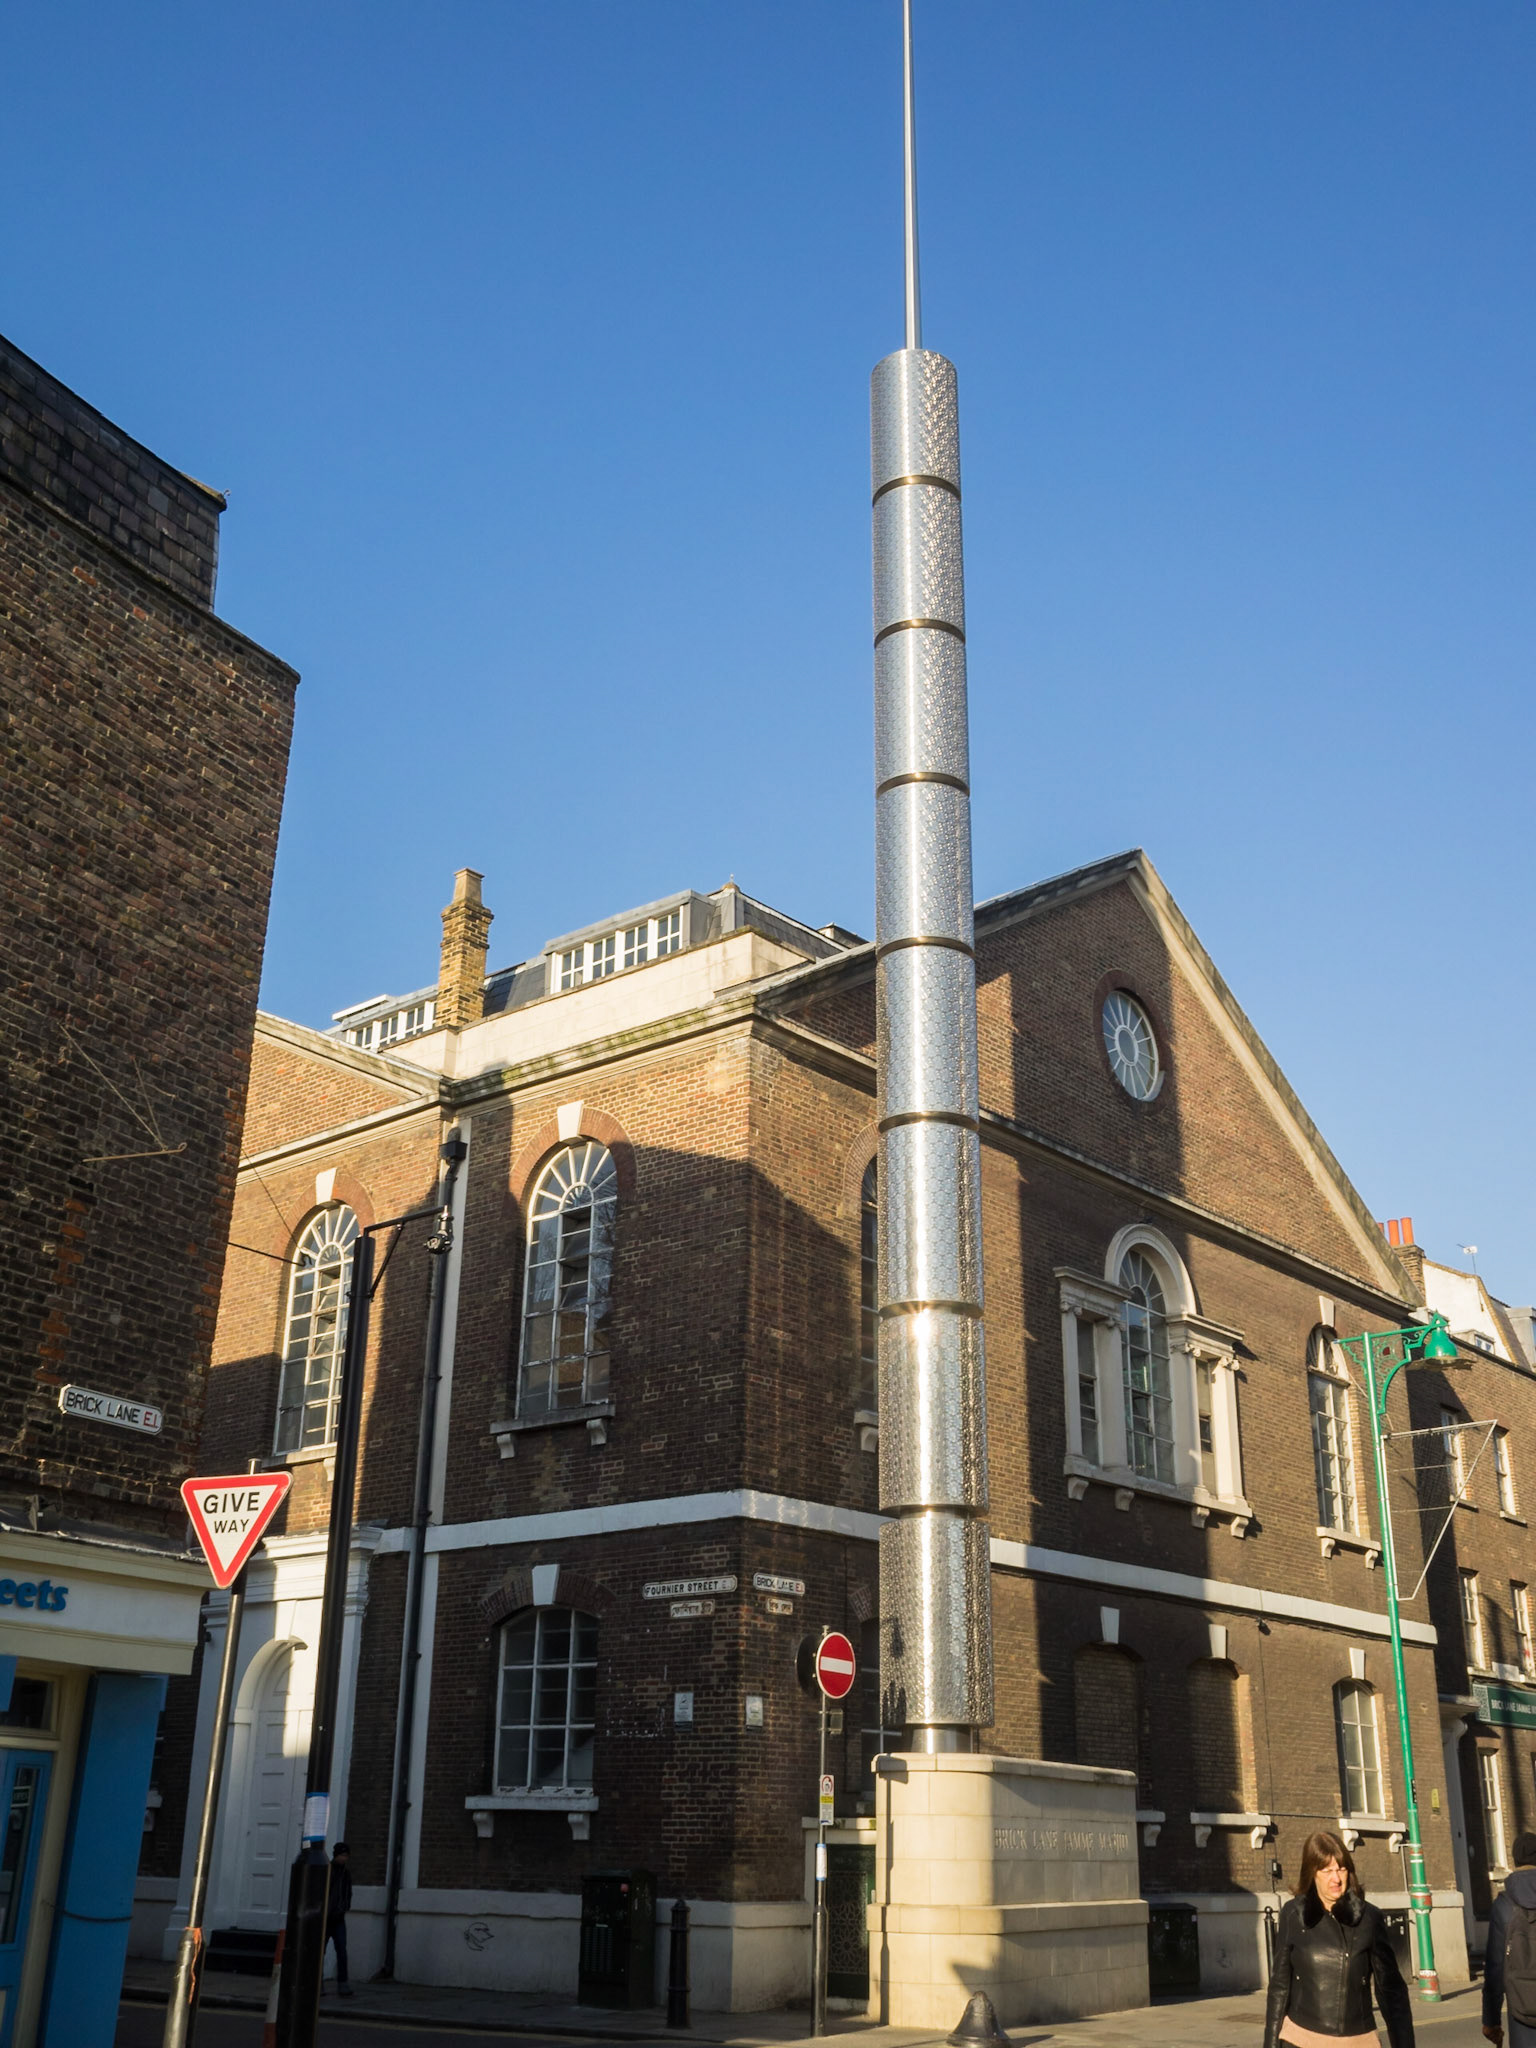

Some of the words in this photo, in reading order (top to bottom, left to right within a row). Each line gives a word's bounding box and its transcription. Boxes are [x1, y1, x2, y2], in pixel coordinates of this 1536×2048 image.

[66, 1391, 103, 1415] BRICK
[106, 1401, 140, 1424] LANE
[203, 1491, 260, 1514] GIVE
[214, 1518, 249, 1534] WAY
[646, 1583, 684, 1595] FOURNIER
[687, 1580, 718, 1592] STREET
[757, 1576, 774, 1589] BRICK
[0, 1578, 69, 1612] eets
[994, 1827, 1027, 1849] BRICK
[1032, 1829, 1058, 1850] LANE
